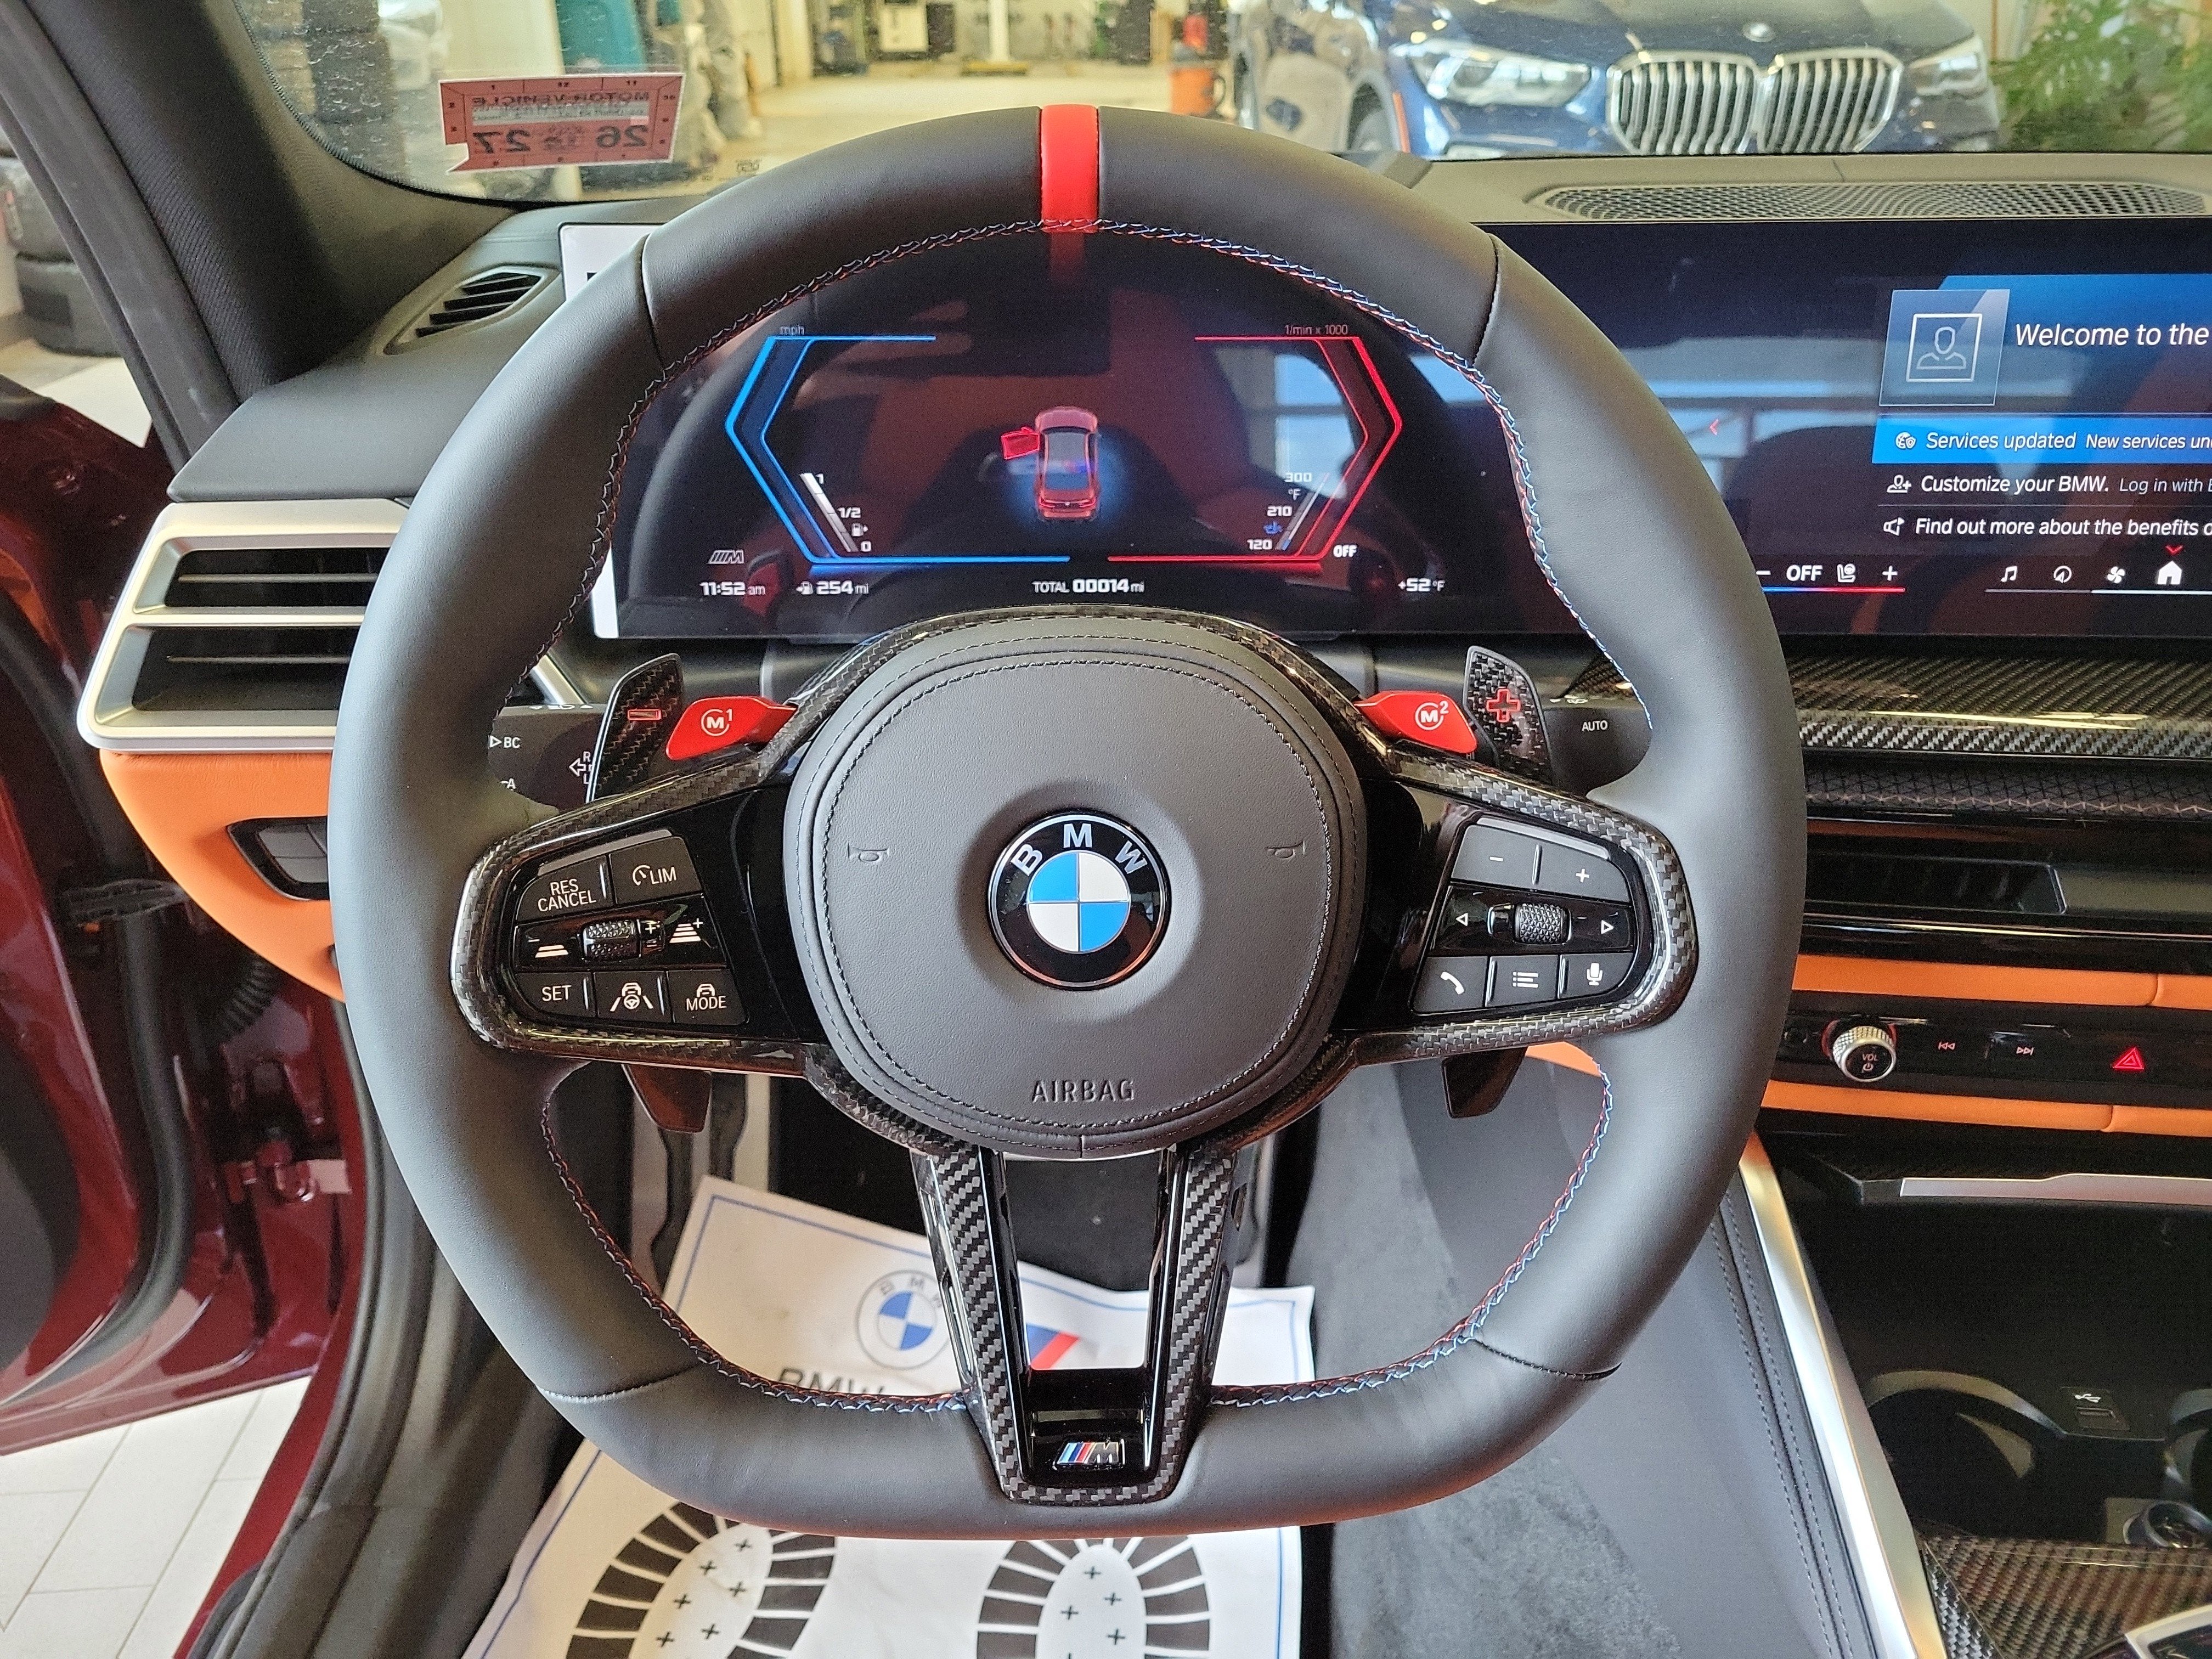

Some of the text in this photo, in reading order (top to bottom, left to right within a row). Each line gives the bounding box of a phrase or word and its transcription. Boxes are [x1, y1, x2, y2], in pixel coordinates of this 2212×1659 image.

[781, 324, 805, 336] mph
[1285, 324, 1313, 335] 1/min
[1324, 324, 1348, 335] 1000
[2016, 323, 2209, 346] Welcome to the
[1926, 432, 2212, 452] Services updated New services un
[1284, 472, 1312, 483] 300
[1921, 475, 2011, 492] Customize
[2013, 478, 2055, 495] your
[2058, 476, 2108, 492] BMW.
[2119, 478, 2149, 495] Log
[2153, 478, 2167, 492] in
[2172, 478, 2203, 492] with
[838, 507, 861, 519] 1/2
[1267, 506, 1293, 516] 210
[1915, 518, 1953, 534] Find
[1956, 519, 1987, 535] out
[1990, 521, 2035, 535] more
[2039, 518, 2090, 535] about
[2094, 518, 2123, 535] the
[2127, 519, 2199, 536] benefits
[861, 541, 872, 552] 0
[1247, 539, 1272, 550] 120
[1333, 545, 1357, 557] OFF
[1786, 565, 1823, 582] OFF
[700, 582, 766, 596] 11:52 am
[816, 580, 869, 595] 254 mi
[1032, 579, 1144, 593] TOTAL 00014 mi
[1398, 578, 1431, 592] +52
[1582, 720, 1608, 731] AUTO
[504, 737, 521, 748] BC
[1010, 823, 1148, 876] BMW
[650, 866, 677, 885] LIM
[549, 878, 579, 896] RES
[538, 890, 597, 912] CANCEL
[541, 985, 572, 1001] SET
[686, 995, 727, 1011] MODE
[1863, 1053, 1878, 1062] VOL
[1032, 1080, 1135, 1103] AIRBAG
